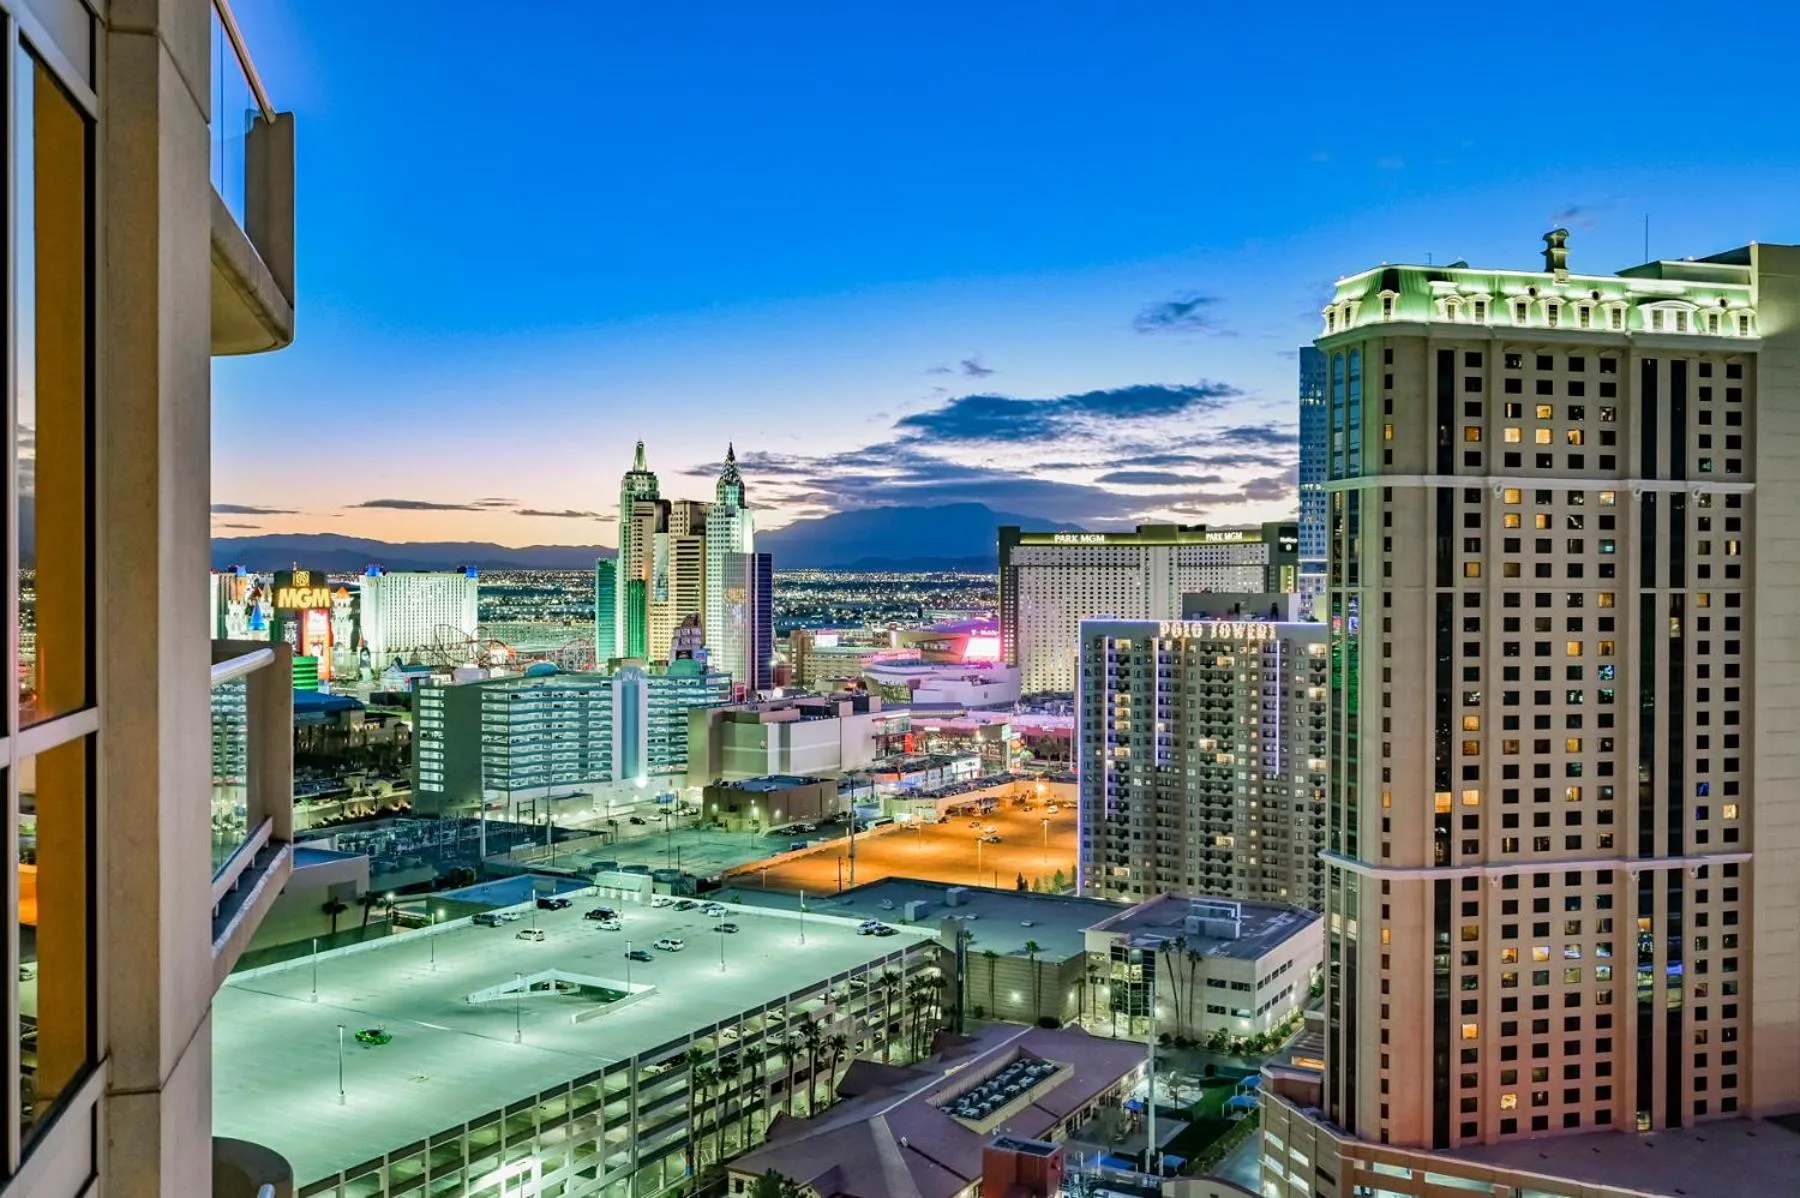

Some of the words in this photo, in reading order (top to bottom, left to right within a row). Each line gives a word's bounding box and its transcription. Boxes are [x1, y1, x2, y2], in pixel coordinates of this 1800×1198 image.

[1054, 534, 1078, 543] PARK
[1080, 534, 1105, 543] MGM
[1206, 533, 1222, 542] PARK
[1224, 532, 1243, 541] MGM
[278, 587, 330, 608] MGM
[1159, 621, 1203, 638] POLO
[1210, 622, 1276, 640] TOWERS
